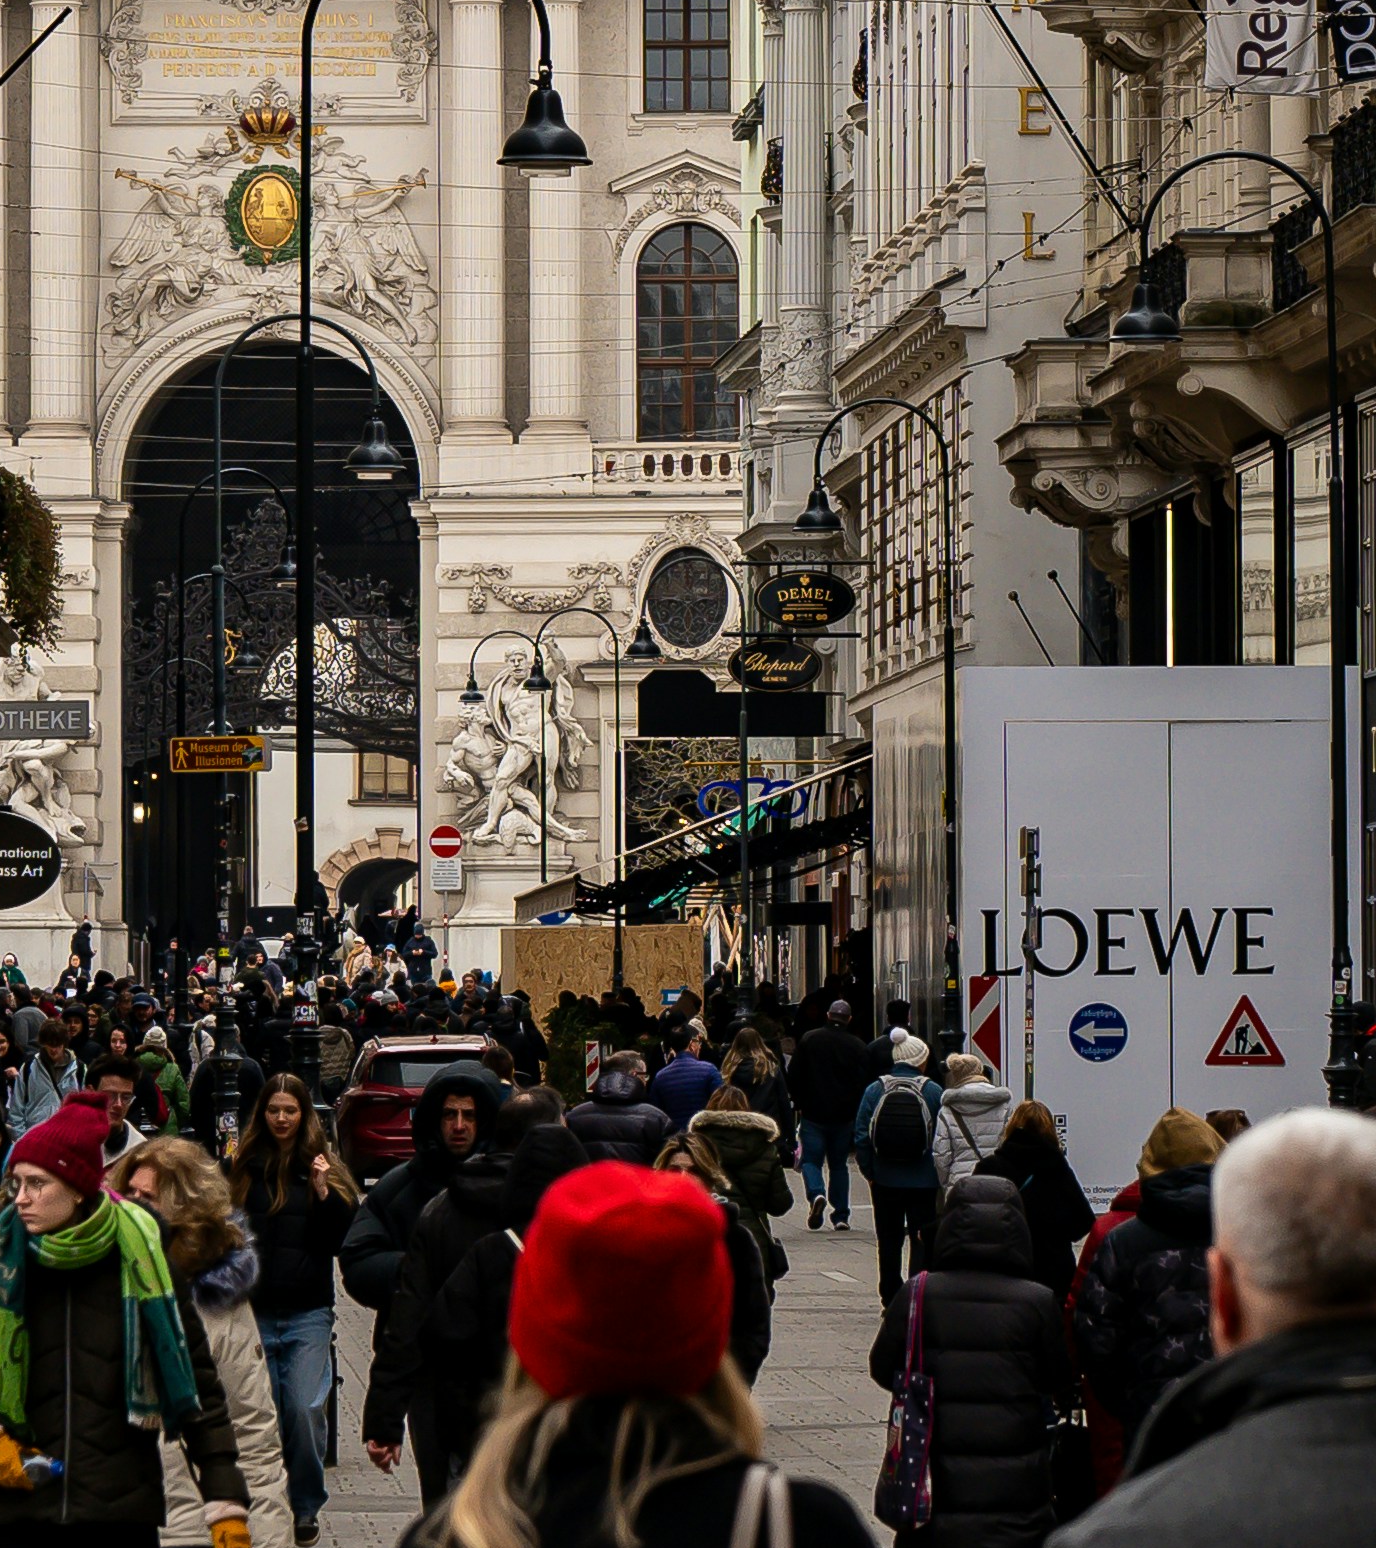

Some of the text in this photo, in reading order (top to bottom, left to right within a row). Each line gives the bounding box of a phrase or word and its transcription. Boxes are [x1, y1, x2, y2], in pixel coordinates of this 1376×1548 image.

[777, 588, 834, 602] DEMEL
[739, 652, 812, 676] Chopard
[191, 743, 229, 753] Museum
[196, 756, 243, 767] Illusionen
[21, 864, 44, 878] Art
[980, 907, 1275, 977] LOEWE
[294, 1005, 316, 1016] FCK
